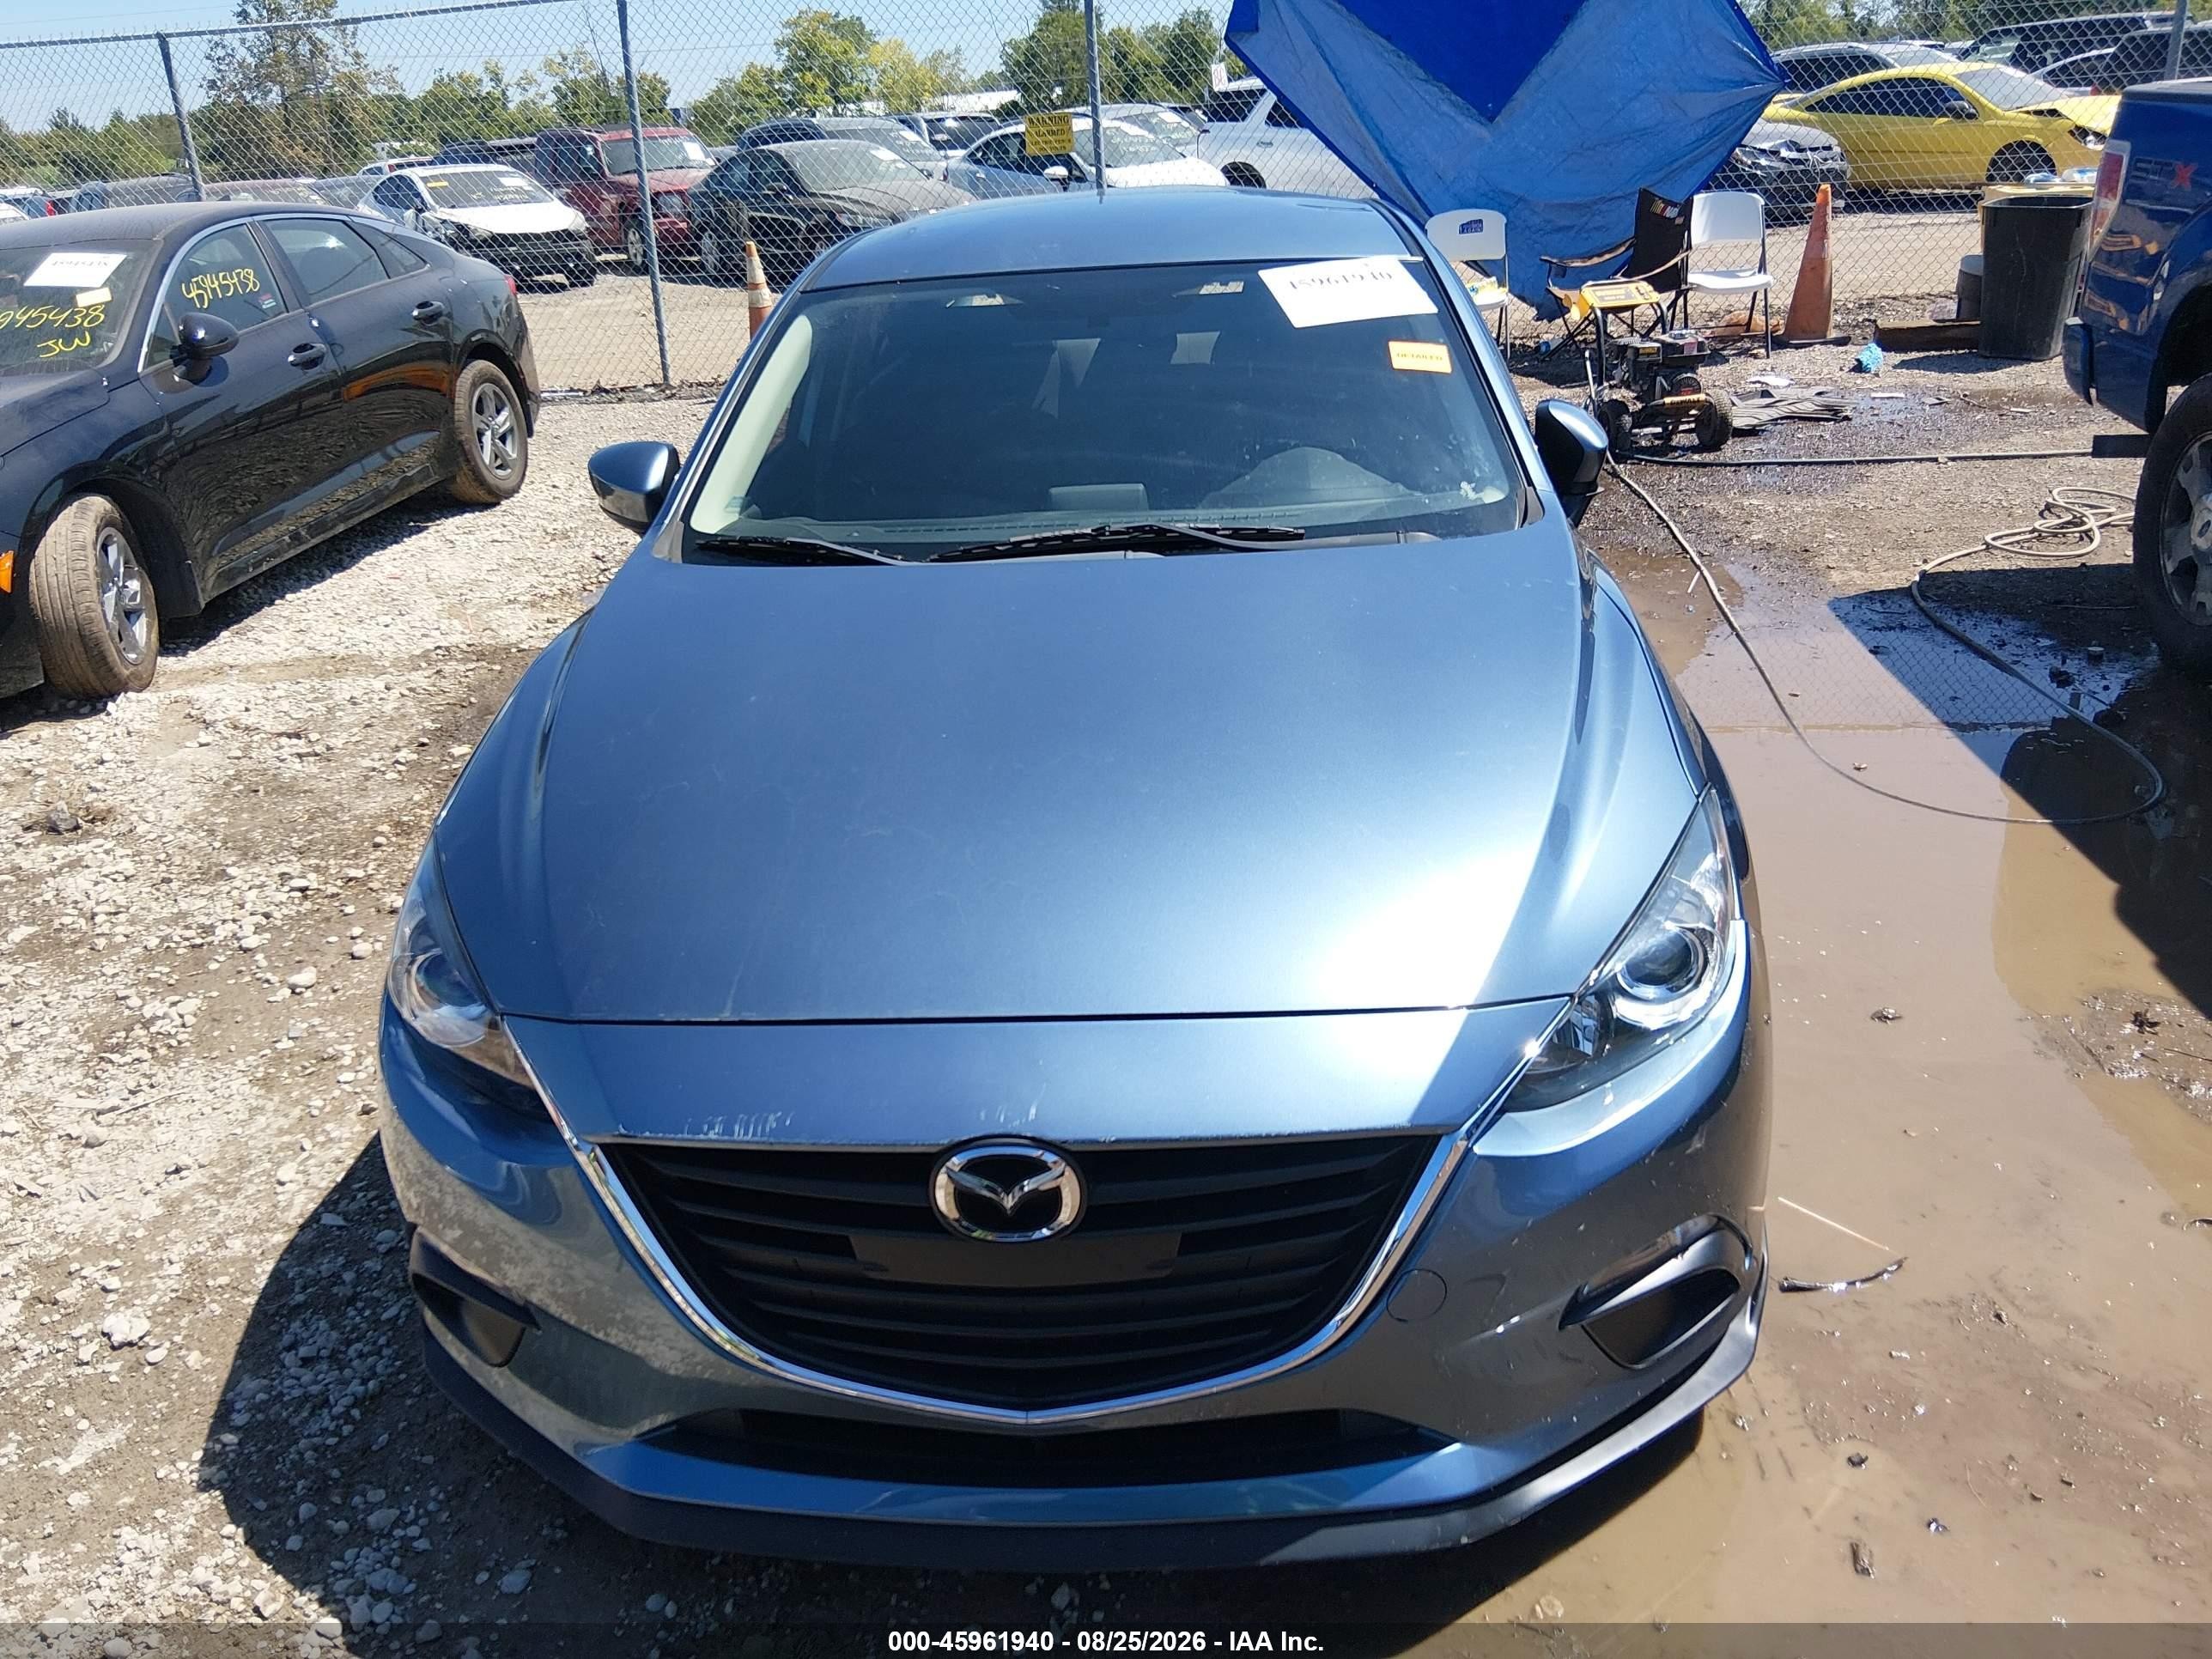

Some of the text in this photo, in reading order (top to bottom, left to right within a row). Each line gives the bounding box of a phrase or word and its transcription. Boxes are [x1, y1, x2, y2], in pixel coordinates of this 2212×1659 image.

[1028, 116, 1069, 125] WARNING
[2130, 156, 2197, 191] STX
[181, 268, 260, 309] 45945438
